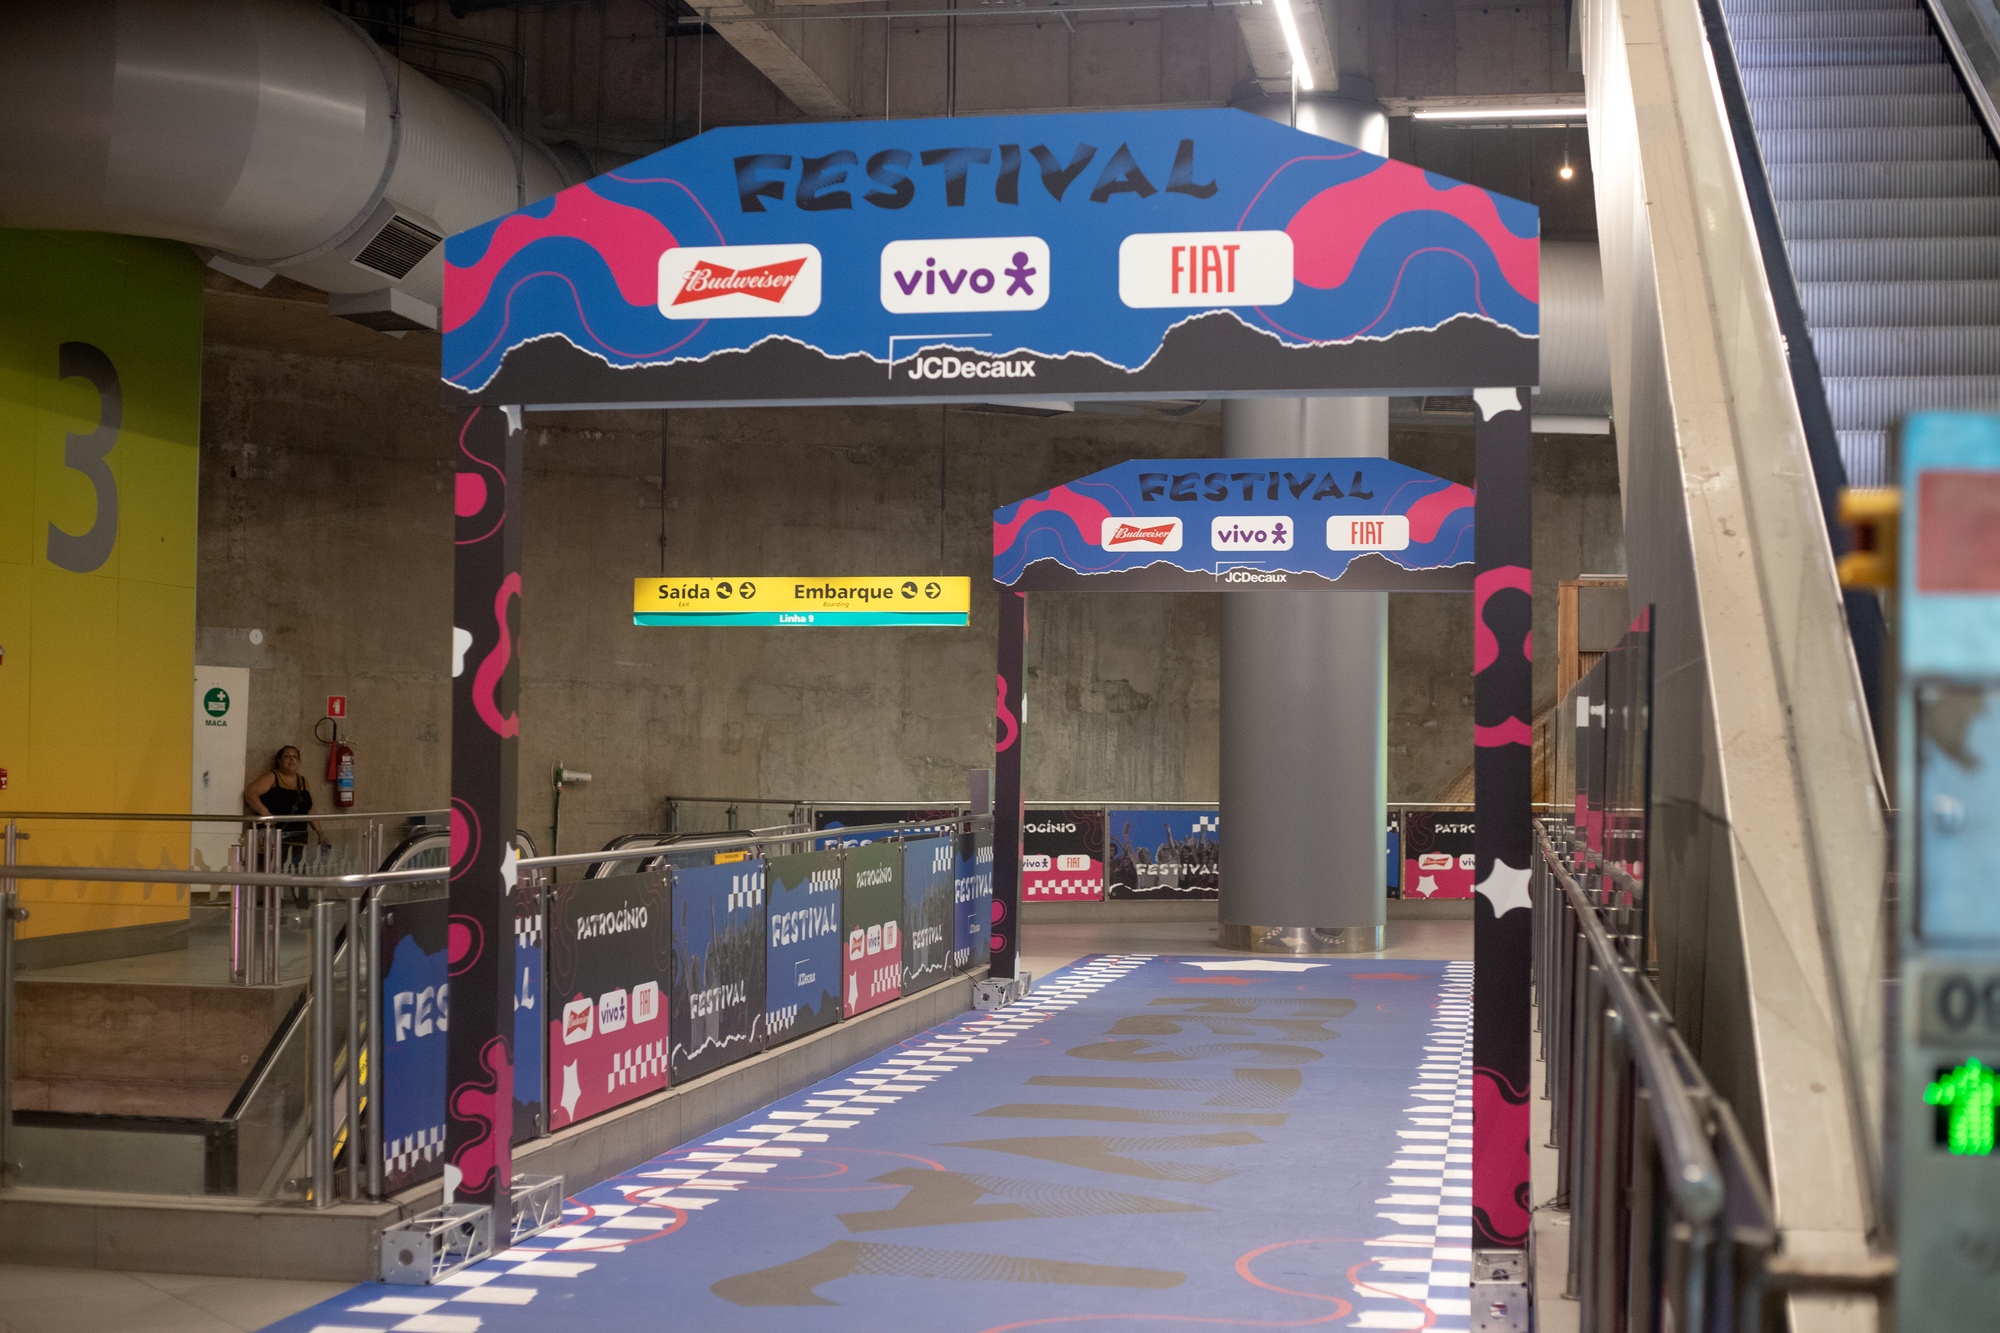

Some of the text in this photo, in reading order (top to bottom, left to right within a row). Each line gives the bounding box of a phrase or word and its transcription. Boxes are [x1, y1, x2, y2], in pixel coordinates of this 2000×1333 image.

[733, 138, 1219, 213] FESTIVAL
[682, 268, 795, 292] Budweiser
[894, 257, 995, 296] vivo
[1171, 244, 1241, 294] FIAT
[908, 356, 1036, 380] JCDecaux
[46, 341, 124, 574] 3
[1138, 471, 1375, 502] FESTIVAL
[1113, 527, 1171, 539] Budweiser
[1217, 524, 1268, 544] vivo
[1351, 521, 1385, 545] FIAT
[1225, 572, 1288, 583] JCDecaux
[658, 584, 710, 599] Saída
[795, 584, 894, 603] Embarque
[779, 614, 815, 623] Linha 9
[205, 719, 228, 727] MACA
[1066, 857, 1081, 869] FIAT
[955, 872, 993, 903] FESTIVAL
[577, 901, 648, 940] PATROCÍNIO
[772, 903, 838, 947] FESTIVAL
[912, 924, 943, 950] FESTIVAL
[690, 980, 747, 1020] FESTIVAL
